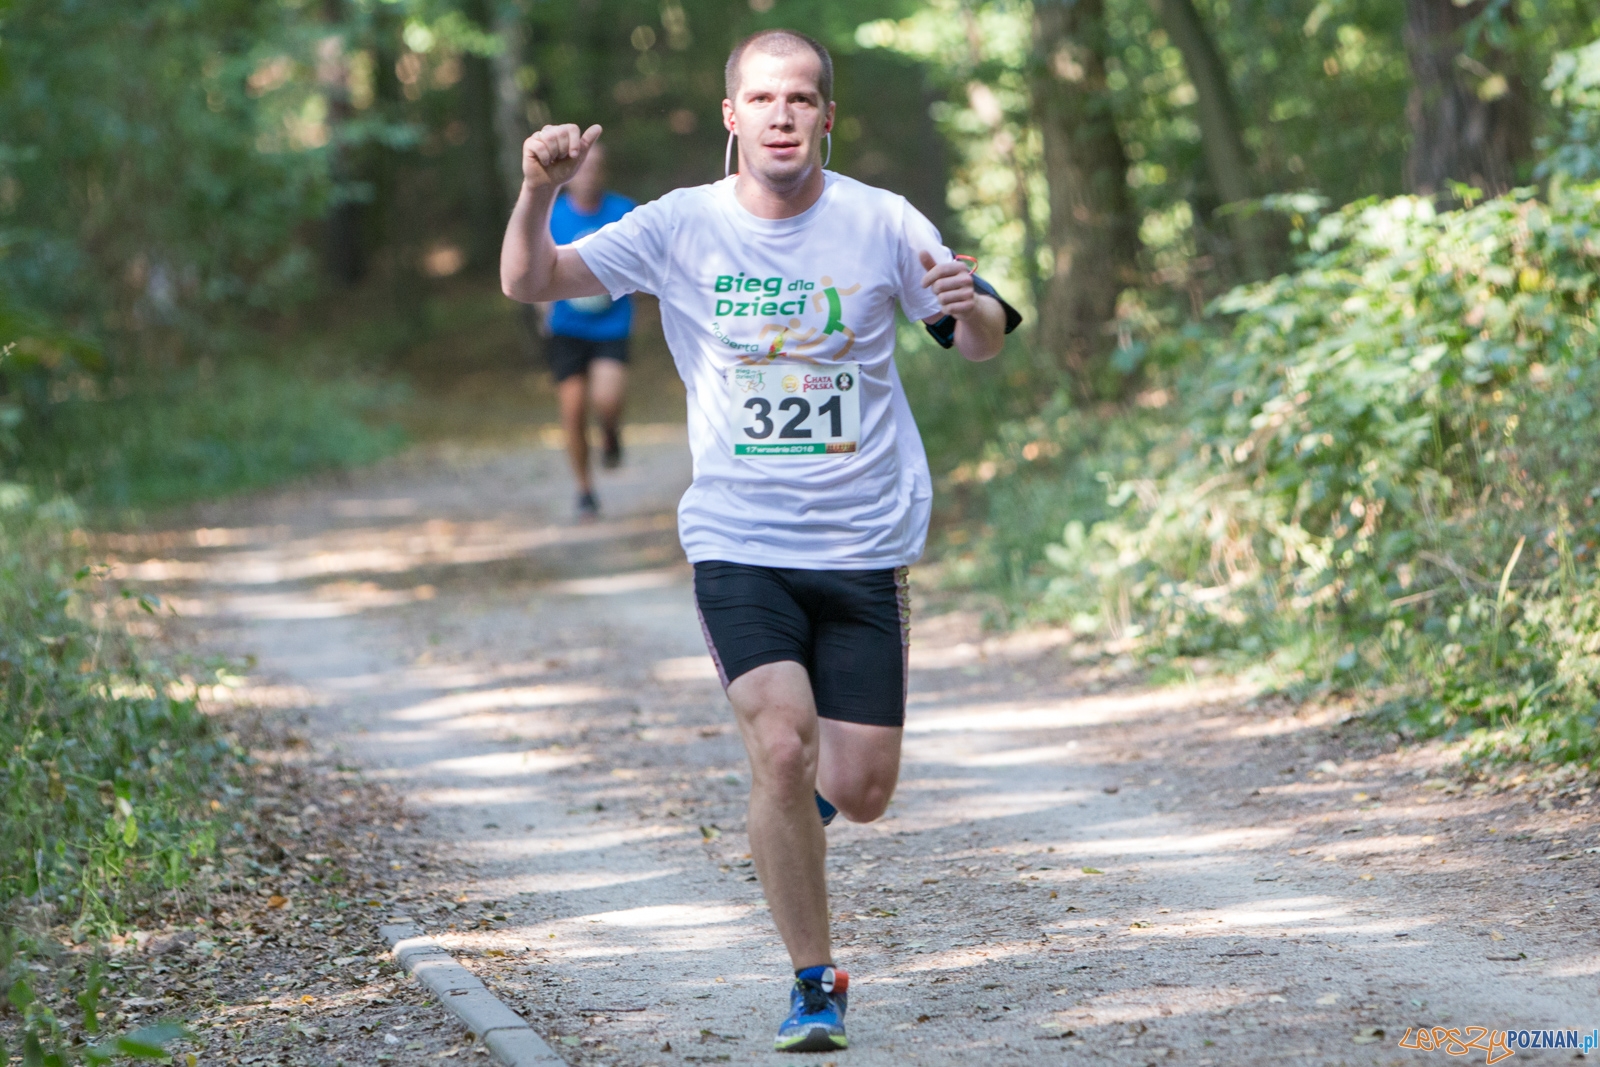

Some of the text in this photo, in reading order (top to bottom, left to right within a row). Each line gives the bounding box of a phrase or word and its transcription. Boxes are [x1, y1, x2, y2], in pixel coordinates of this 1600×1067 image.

[715, 273, 814, 296] Bieg dla
[715, 294, 806, 316] Dzieci
[712, 320, 758, 352] Roberta
[803, 383, 834, 392] POLSKA
[804, 374, 832, 383] CHATA
[744, 395, 842, 439] 321
